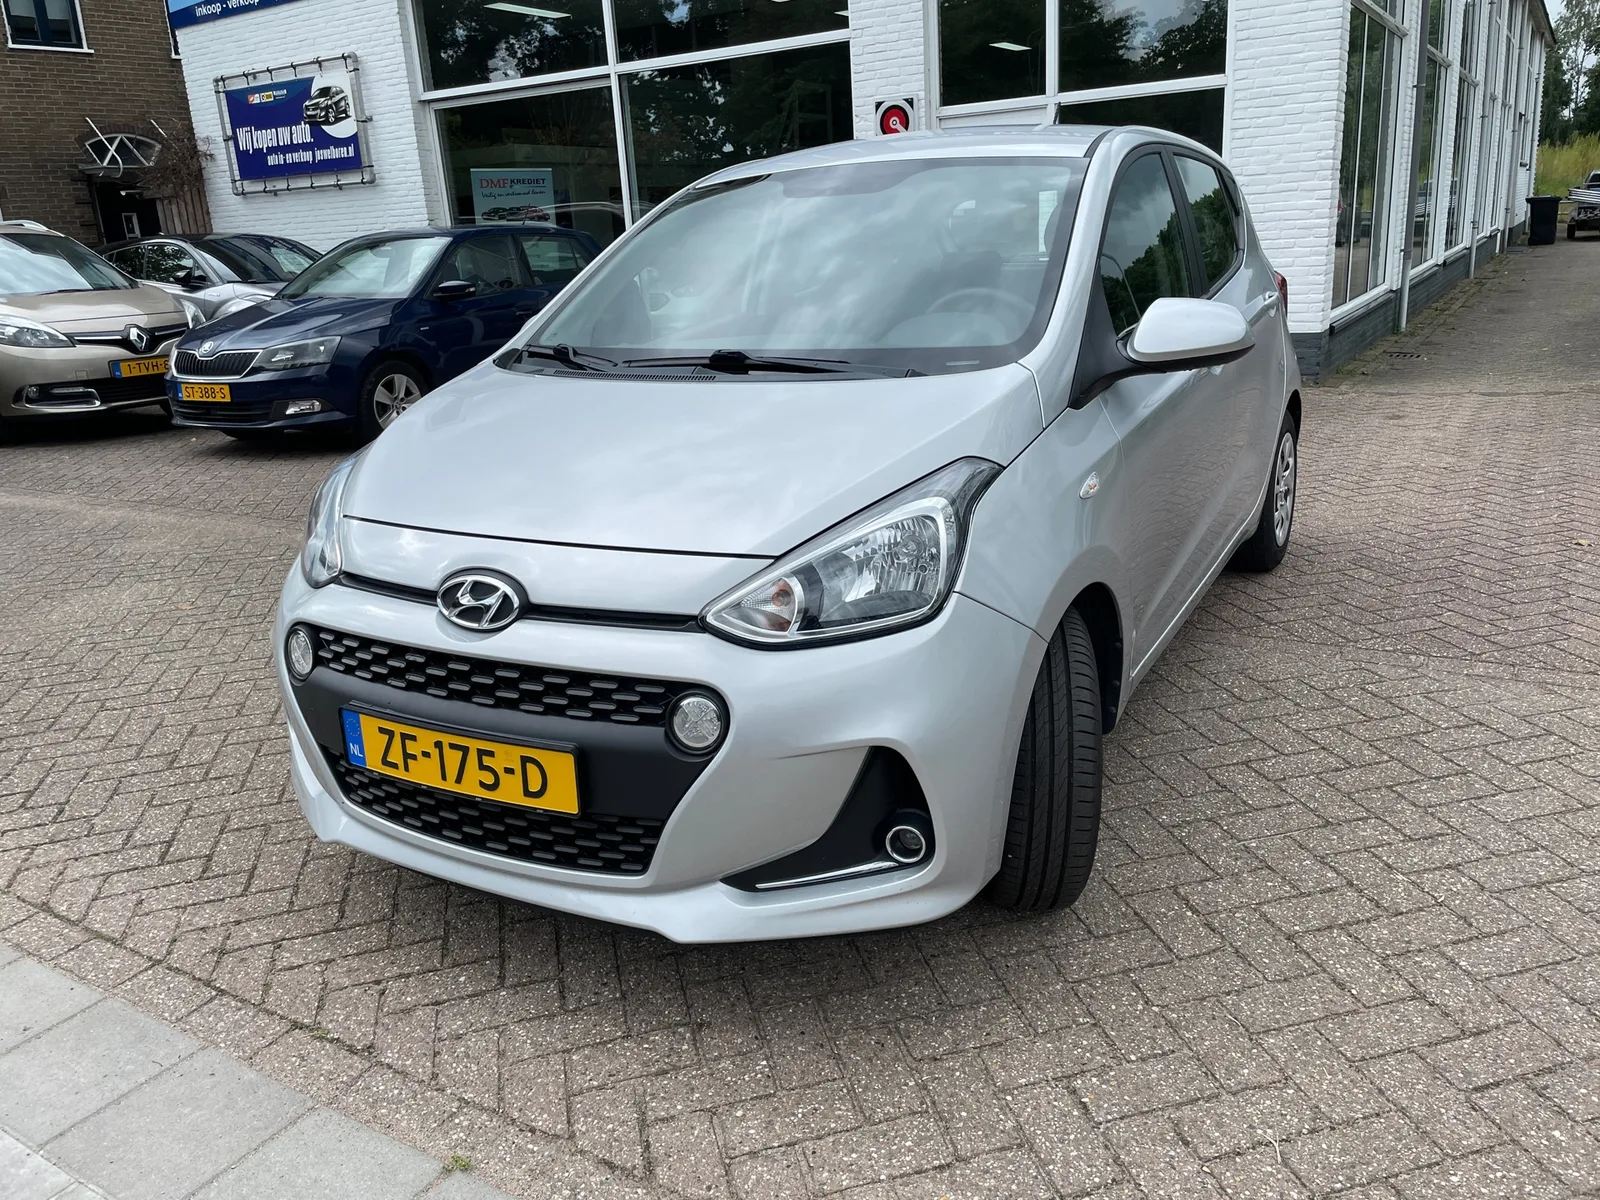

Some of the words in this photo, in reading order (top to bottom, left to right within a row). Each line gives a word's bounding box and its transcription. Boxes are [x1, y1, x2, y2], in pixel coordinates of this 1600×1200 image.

[195, 2, 222, 17] inkoop
[236, 126, 253, 154] Wij
[251, 126, 278, 153] kopen
[277, 126, 291, 146] uw
[291, 121, 314, 145] auto.
[267, 153, 279, 166] auto
[292, 149, 313, 164] verkoop
[479, 178, 508, 189] DMF
[184, 386, 226, 399] ST-388-S
[350, 742, 364, 758] NL
[377, 726, 548, 799] ZF-175-D
